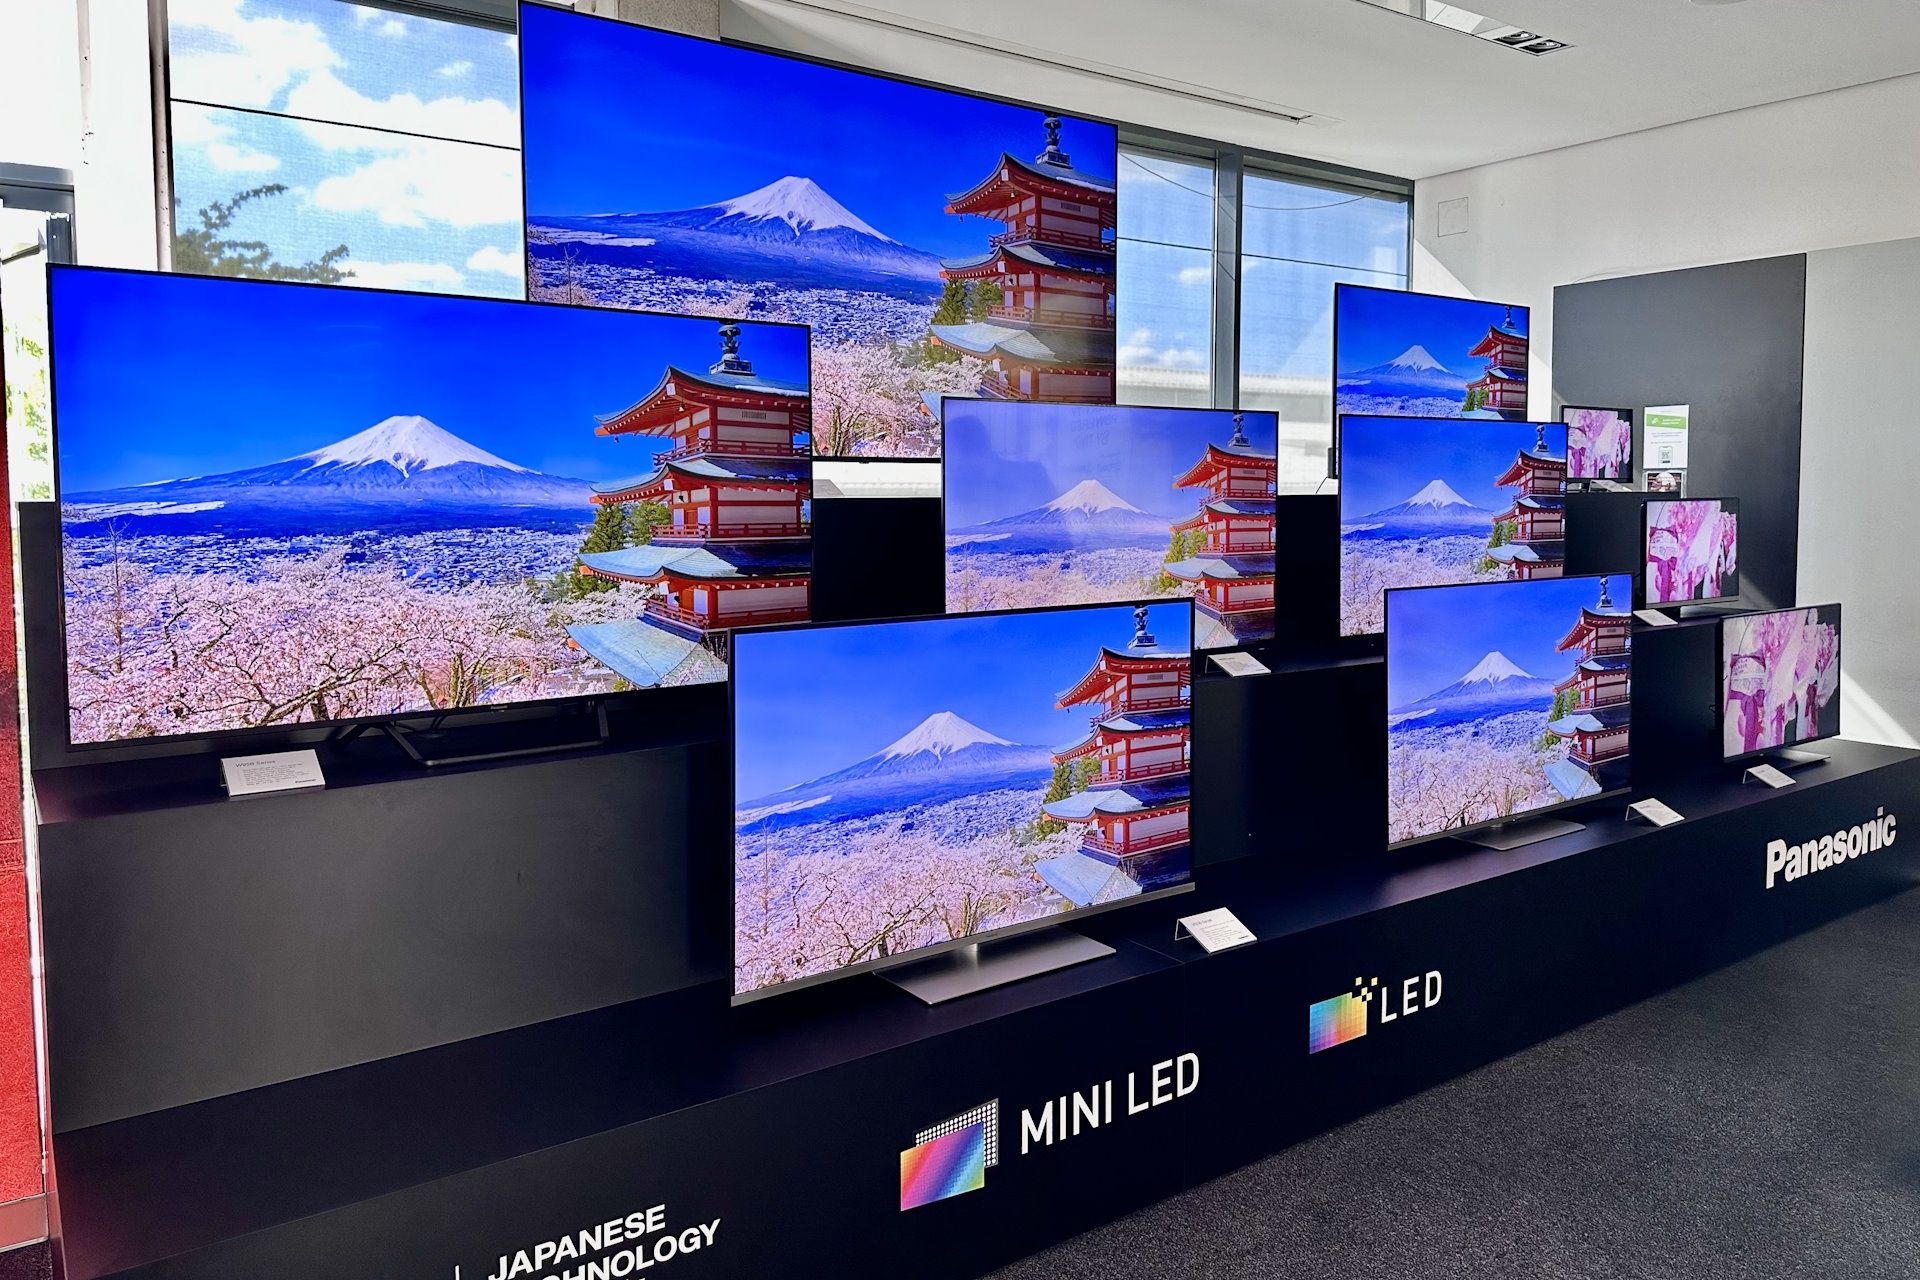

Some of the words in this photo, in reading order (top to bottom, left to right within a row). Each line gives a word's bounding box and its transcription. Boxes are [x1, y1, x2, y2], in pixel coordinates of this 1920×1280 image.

[1765, 806, 1897, 890] Panasonic
[1381, 970, 1443, 1024] LED
[1021, 1079, 1113, 1155] MINI
[1128, 1052, 1200, 1116] LED
[488, 1203, 666, 1280] JAPANESE
[542, 1218, 721, 1280] HNOLOGY
